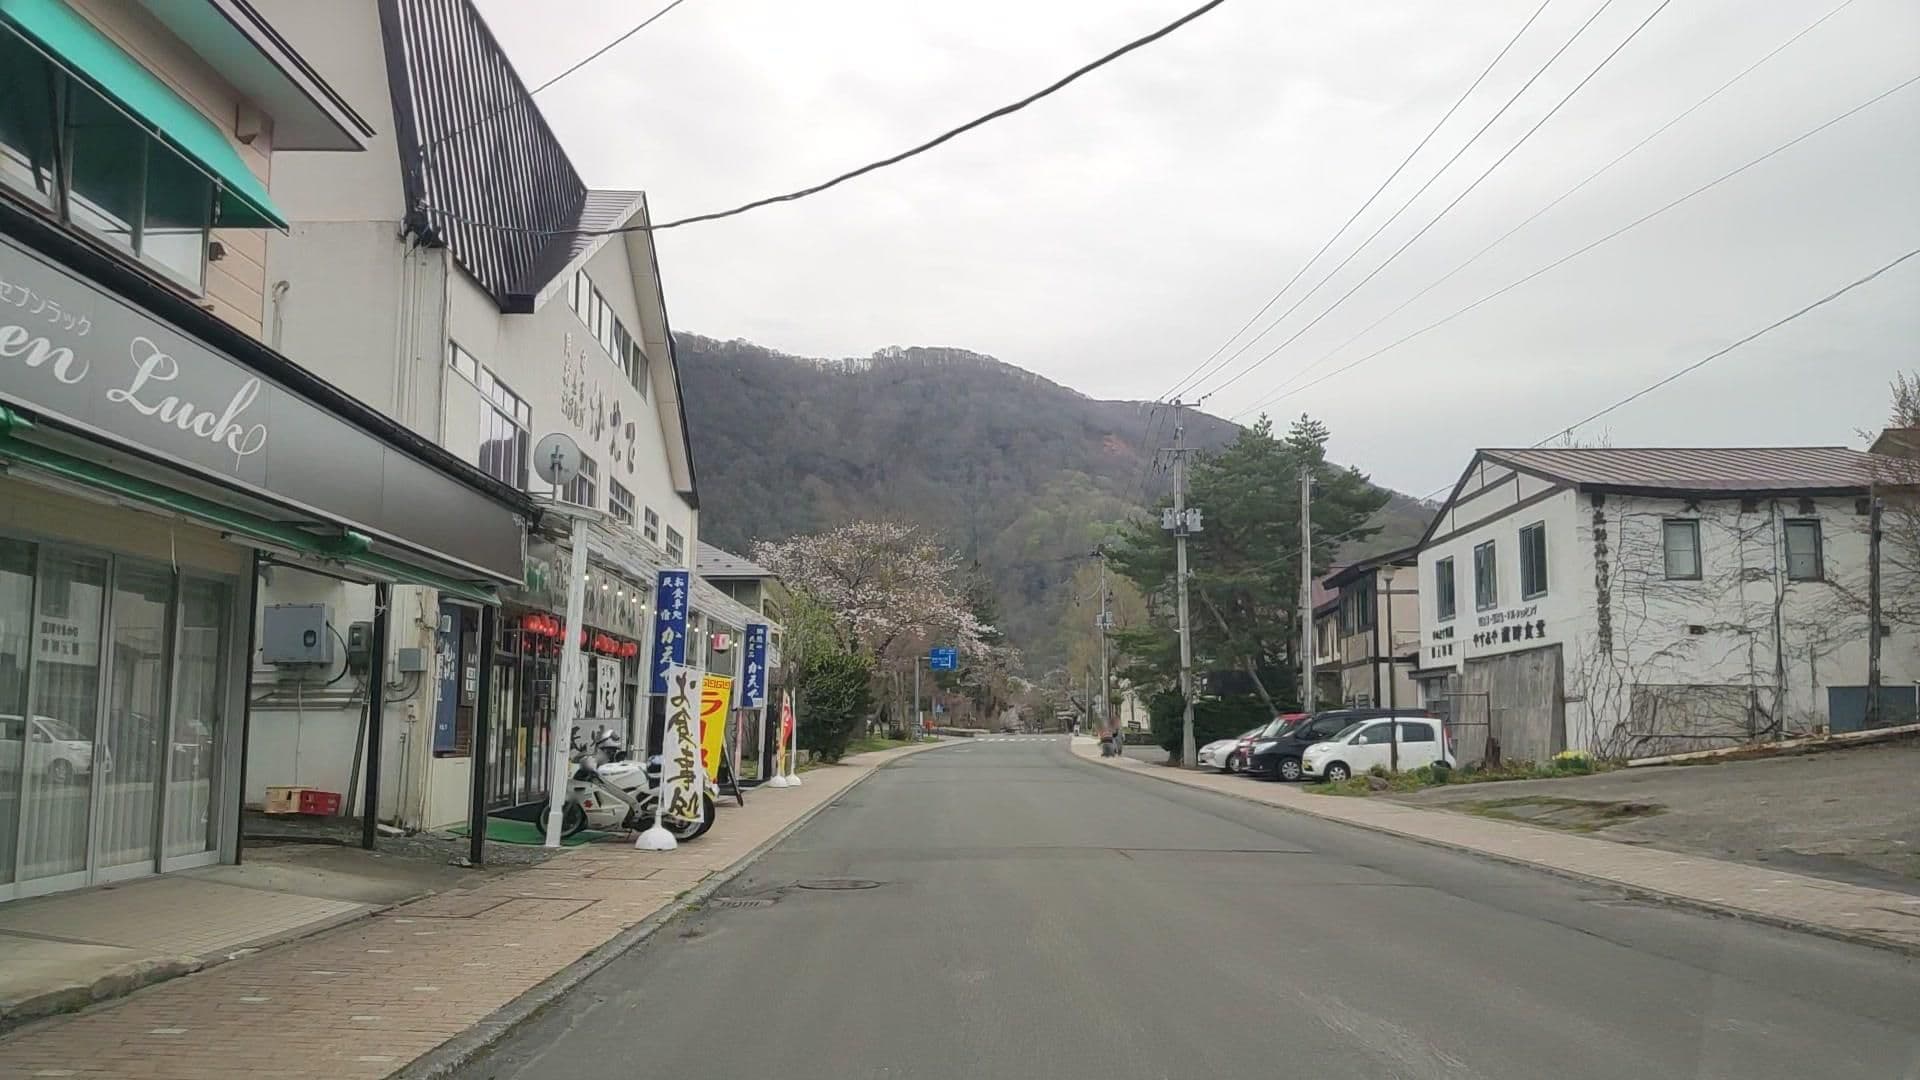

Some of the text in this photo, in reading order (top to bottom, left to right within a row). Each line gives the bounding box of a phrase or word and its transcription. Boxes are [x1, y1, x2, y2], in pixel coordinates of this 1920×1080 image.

[107, 335, 268, 472] Luck
[672, 576, 685, 620] お食事処
[667, 671, 700, 819] お食事処
